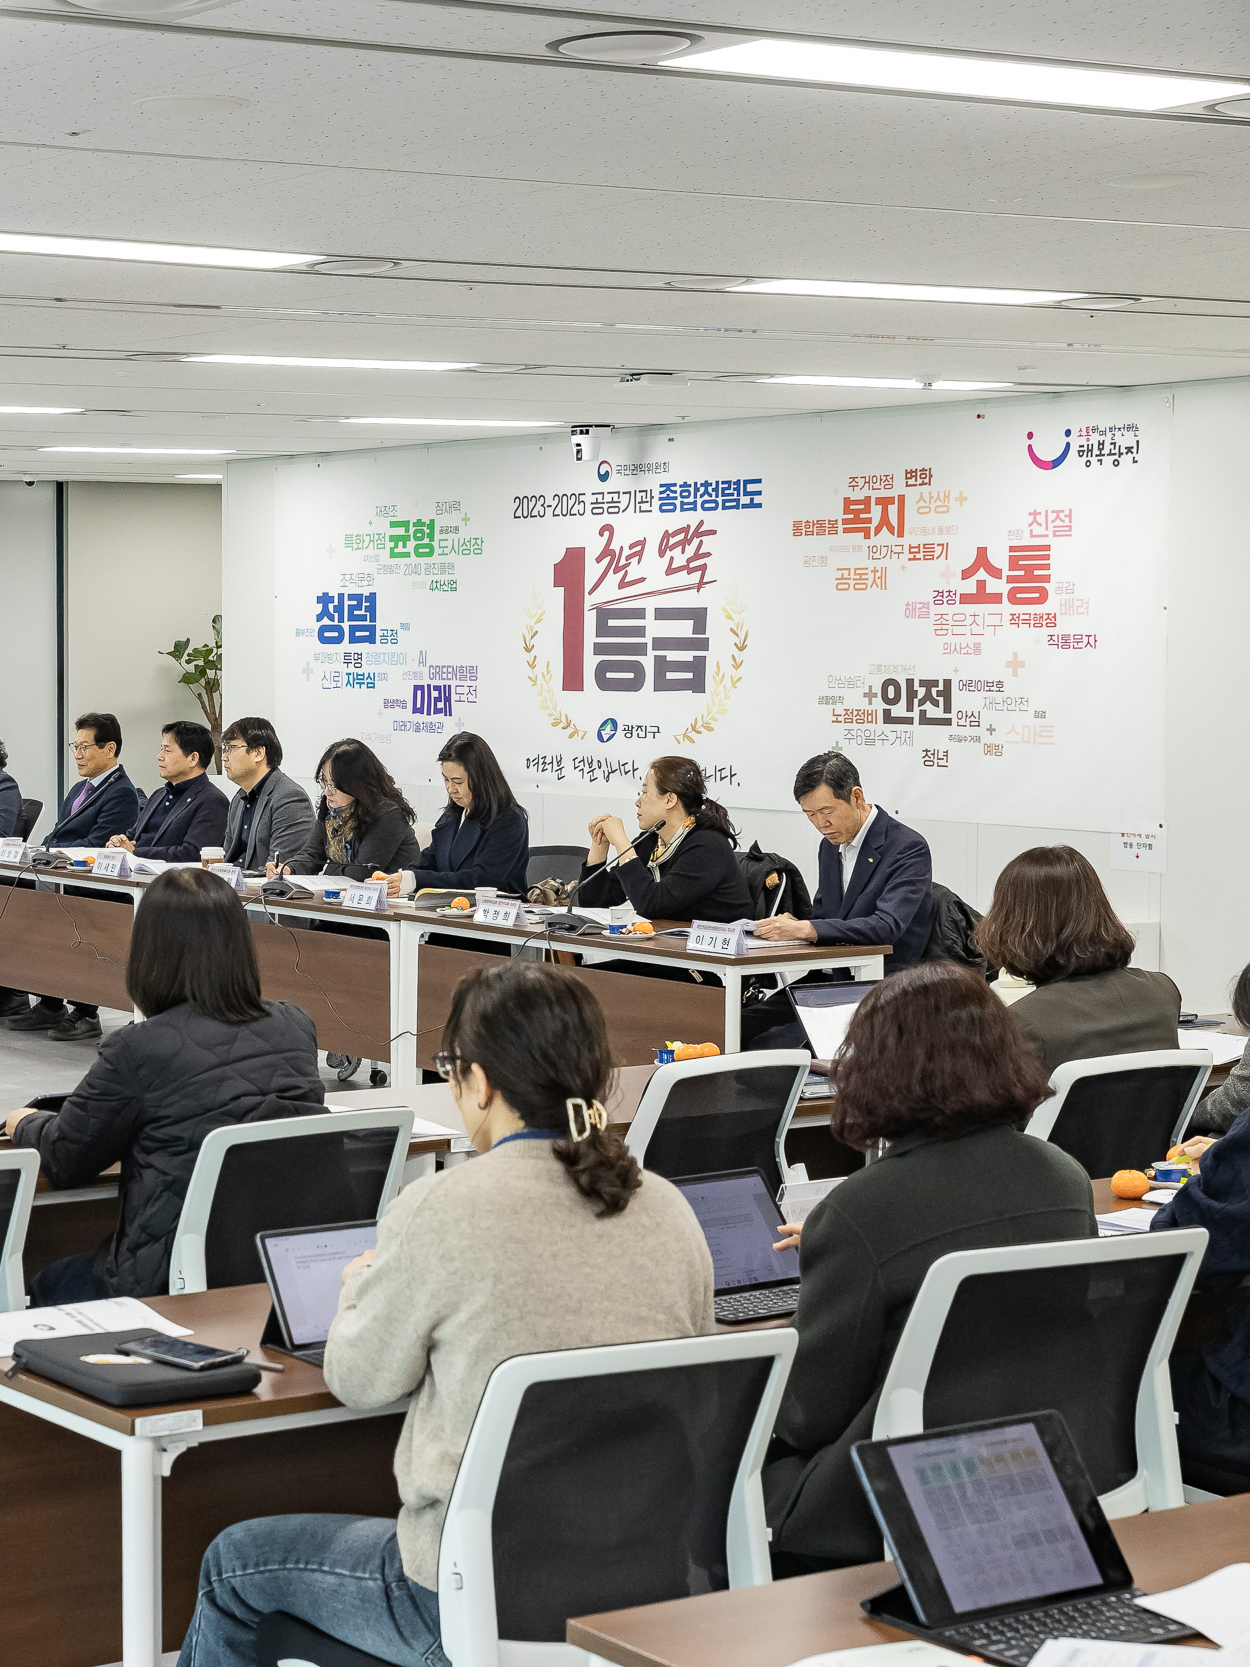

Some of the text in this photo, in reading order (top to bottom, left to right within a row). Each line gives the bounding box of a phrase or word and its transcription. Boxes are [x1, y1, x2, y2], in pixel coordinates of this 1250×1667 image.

[1077, 423, 1140, 443] 소통하며 발전하는
[1077, 440, 1140, 468] 행복광진
[615, 461, 670, 476] 국민권익위원회
[905, 467, 933, 488] 변화
[848, 474, 894, 492] 주거안정
[435, 500, 461, 515] 잠재력
[513, 478, 763, 519] 2023-2025 공공기관 종합청렴도
[916, 490, 951, 515] 상생
[375, 504, 398, 518] 재창조
[841, 494, 906, 540] 복지
[792, 519, 839, 537] 통합돌봄
[1028, 508, 1073, 539] 친절
[344, 532, 386, 551] 특화거점
[388, 519, 435, 559] 균형
[437, 537, 484, 556] 도시성장
[588, 519, 717, 596] 3년 연속
[867, 542, 949, 562] 1인가구 보듬기
[403, 563, 422, 576] 2040
[803, 555, 828, 568] 광진형
[340, 572, 374, 588] 조직문화
[834, 566, 888, 592] 공동체
[959, 544, 1051, 605] 소통
[429, 579, 458, 592] 4차산업
[1054, 581, 1076, 595] 공감
[932, 589, 957, 606] 경청
[904, 601, 931, 620] 해결
[1059, 598, 1090, 617] 배려
[316, 592, 377, 644] 청렴
[553, 547, 710, 693] 1등급
[932, 612, 1004, 637] 좋은친구
[1009, 612, 1057, 629] 적극행정
[379, 628, 399, 645] 공정
[1047, 634, 1098, 650] 직통문자
[942, 642, 982, 656] 의사소통
[342, 652, 363, 668] 투명
[365, 652, 407, 666] 청렴지킴이
[418, 650, 427, 667] AI
[321, 670, 344, 690] 신뢰
[345, 672, 376, 689] 자부심
[428, 665, 478, 682] GREEN힐링
[455, 685, 478, 703] 도전
[958, 679, 1005, 693] 어린이보호
[383, 699, 408, 709] 평생학습
[412, 684, 453, 717] 미래
[880, 677, 952, 727] 안전
[982, 696, 1029, 712] 재난안전
[831, 708, 878, 725] 노점정비
[956, 710, 981, 728] 안심
[393, 720, 444, 734] 미래기술체험관
[621, 724, 661, 739] 광진구
[1005, 723, 1055, 746] 스마트
[843, 728, 915, 748] 주6일수거제
[921, 748, 949, 768] 청년
[983, 743, 1004, 757] 예방
[525, 753, 566, 781] 여러분
[572, 756, 643, 783] 덕분입니다.
[695, 934, 731, 950] 이기현
